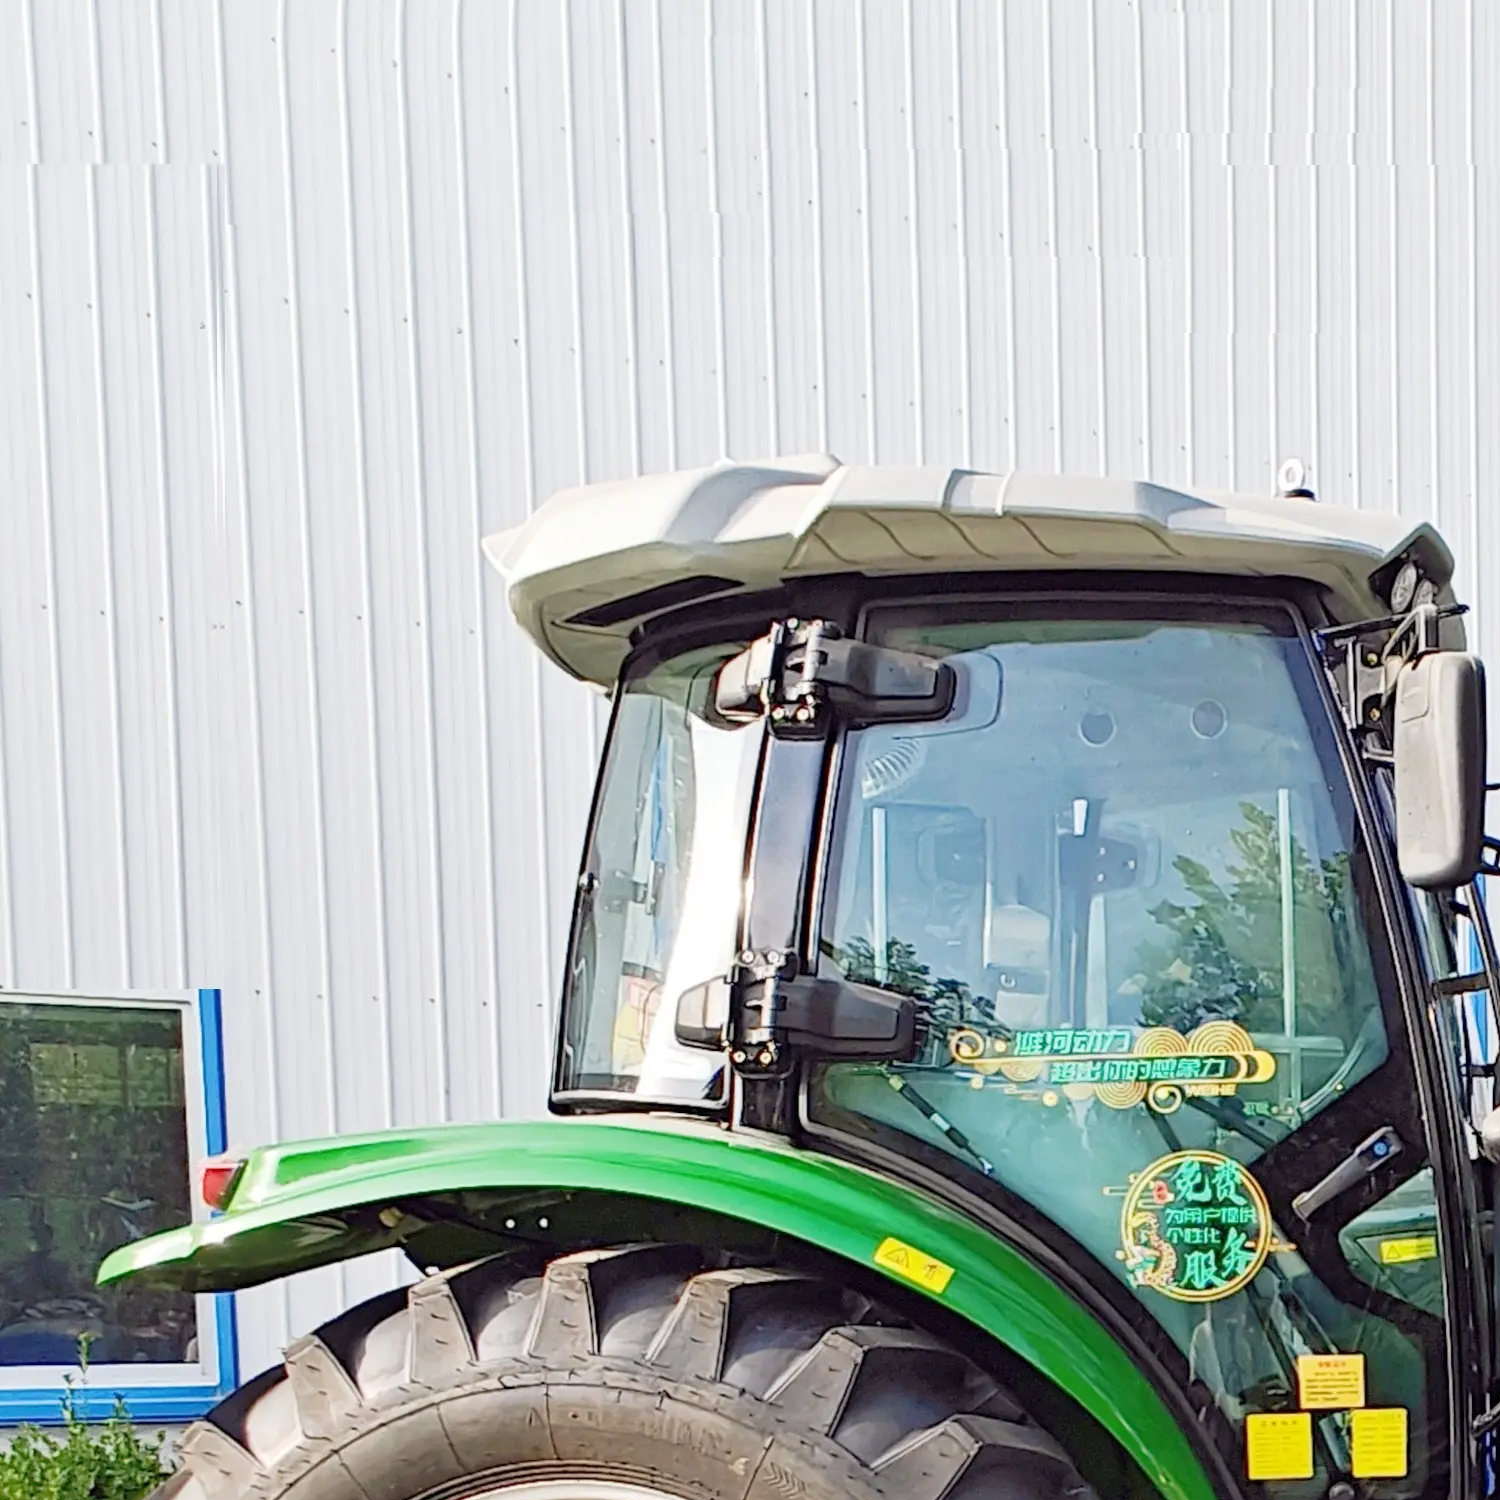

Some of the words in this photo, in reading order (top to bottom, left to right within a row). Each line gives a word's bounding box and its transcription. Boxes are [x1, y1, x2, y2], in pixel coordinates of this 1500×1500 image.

[1051, 1058, 1226, 1083] 超出你的想象力
[1170, 1160, 1248, 1206] 免费
[1165, 1206, 1257, 1225] 为用户提供
[1166, 1227, 1221, 1244] 个性化
[1179, 1227, 1258, 1290] 服务
